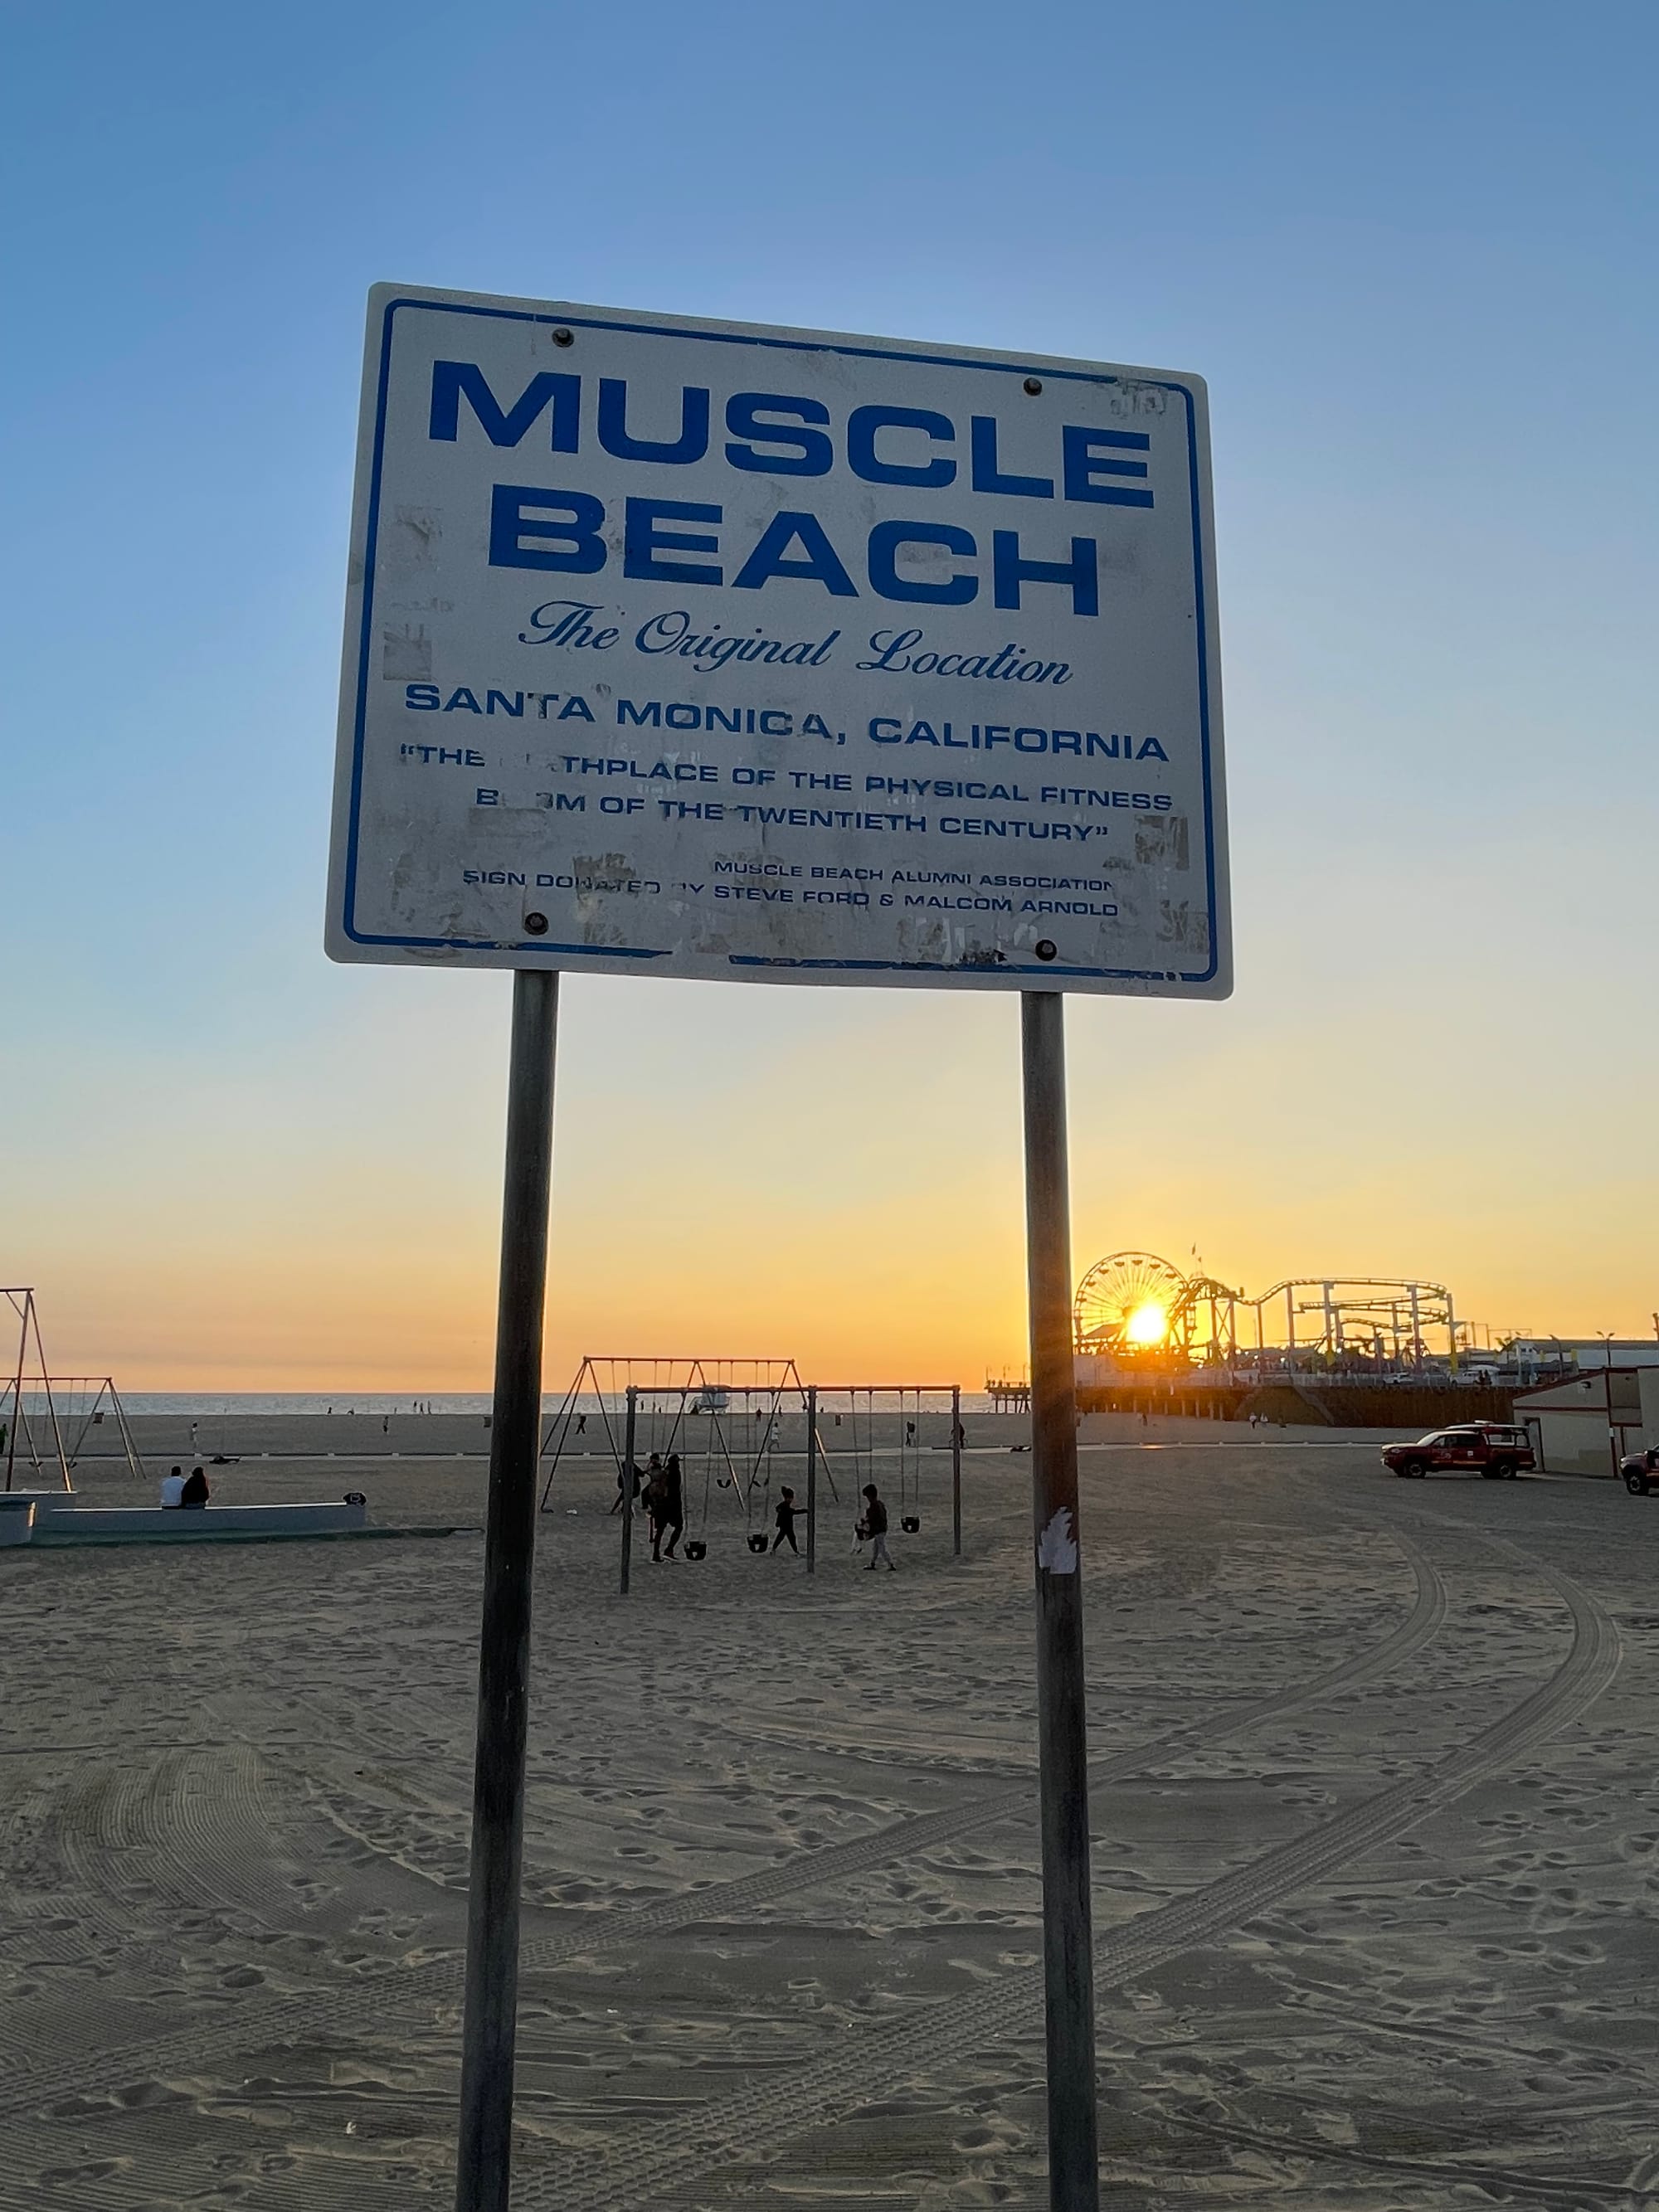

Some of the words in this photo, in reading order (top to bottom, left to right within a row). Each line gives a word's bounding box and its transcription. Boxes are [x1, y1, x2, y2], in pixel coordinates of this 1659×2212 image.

[429, 360, 1155, 508] MUSCLE
[489, 484, 1098, 616] BEACH
[518, 600, 620, 650] The
[635, 610, 842, 673] Original
[856, 629, 1073, 685] Location
[406, 684, 596, 722] SANTA
[617, 699, 846, 746] MONICA,
[868, 717, 1170, 762] CALIFORNIA
[499, 751, 718, 782] THPLACE
[732, 768, 776, 785] OF
[789, 772, 851, 790] THE
[865, 776, 1029, 802] PHYSICAL
[1041, 786, 1173, 810] FITNESS
[600, 796, 645, 814] OF
[658, 800, 723, 820] THE
[737, 805, 927, 832] TWENTIETH
[463, 870, 526, 886] SIGN
[714, 885, 793, 902] STEVE
[803, 891, 870, 906] FORD
[879, 893, 893, 907] &
[905, 894, 1012, 912] MALCOM
[1020, 899, 1118, 916] ARNOLD
[714, 861, 802, 877] MUSCLE
[811, 866, 883, 881] BEACH
[891, 871, 971, 885] ALUMNI
